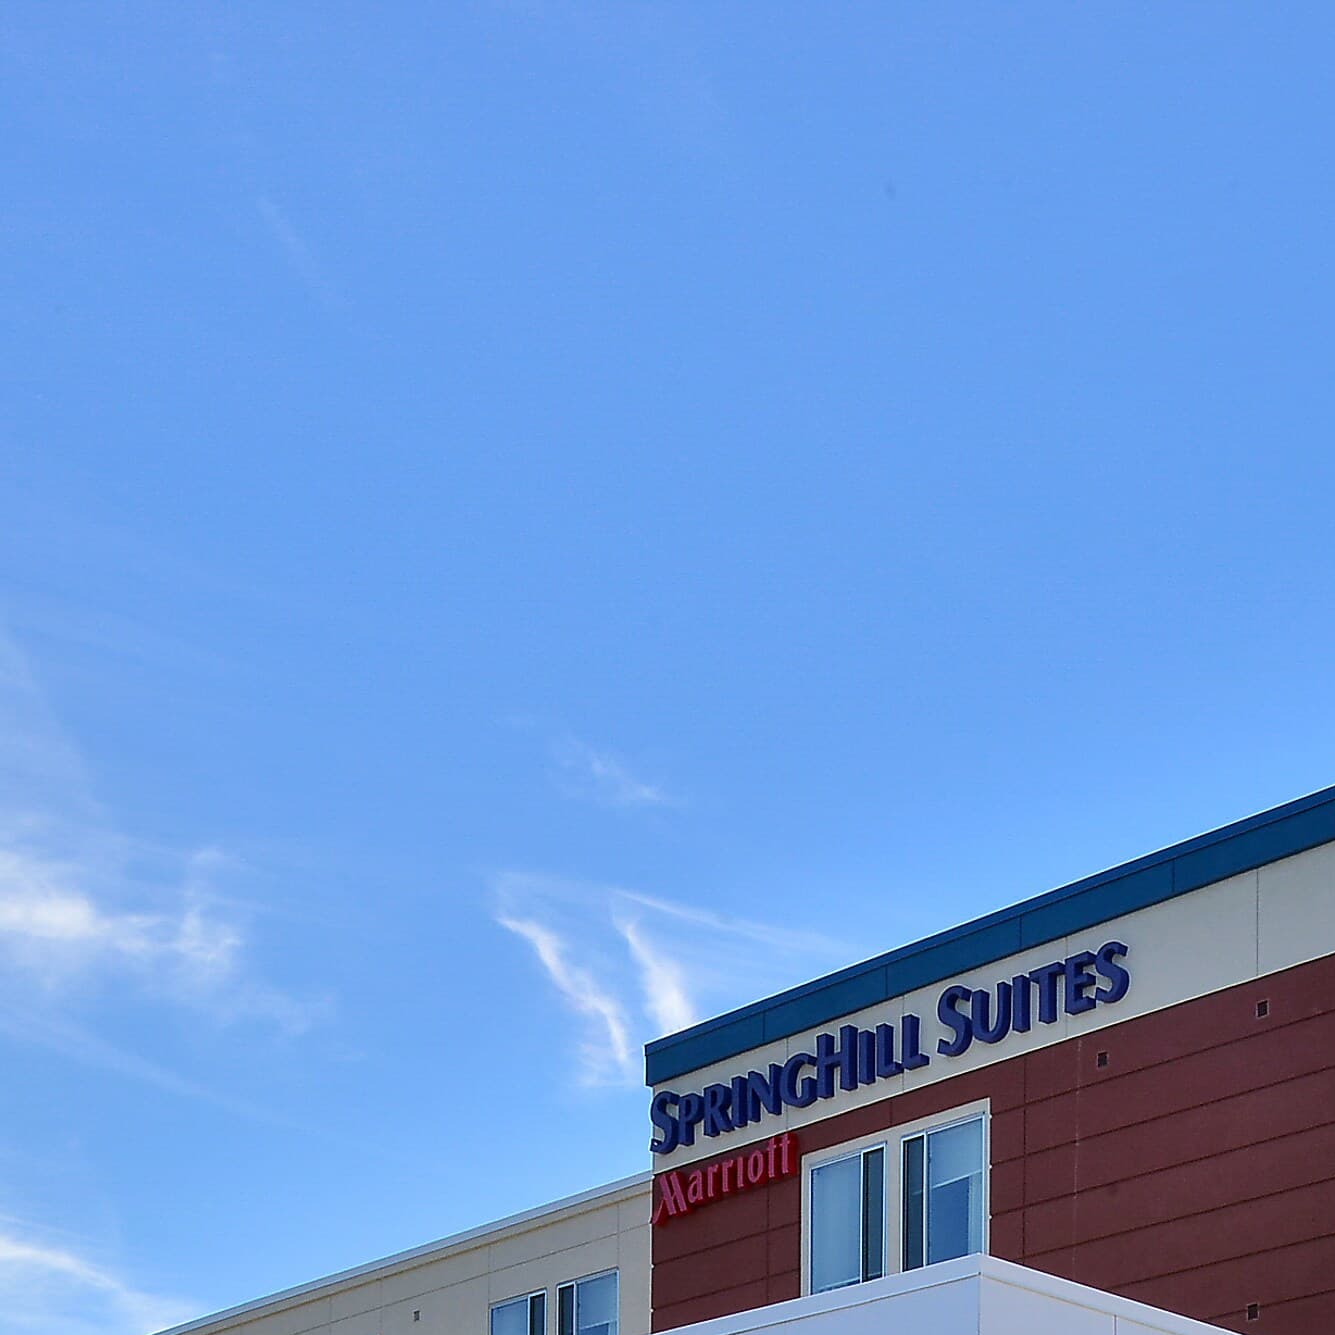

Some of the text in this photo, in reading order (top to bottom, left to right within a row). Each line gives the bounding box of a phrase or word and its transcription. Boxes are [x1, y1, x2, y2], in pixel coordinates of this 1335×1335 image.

[650, 940, 1131, 1155] SPRINGHILL SUITES
[651, 1132, 797, 1226] Marriott
